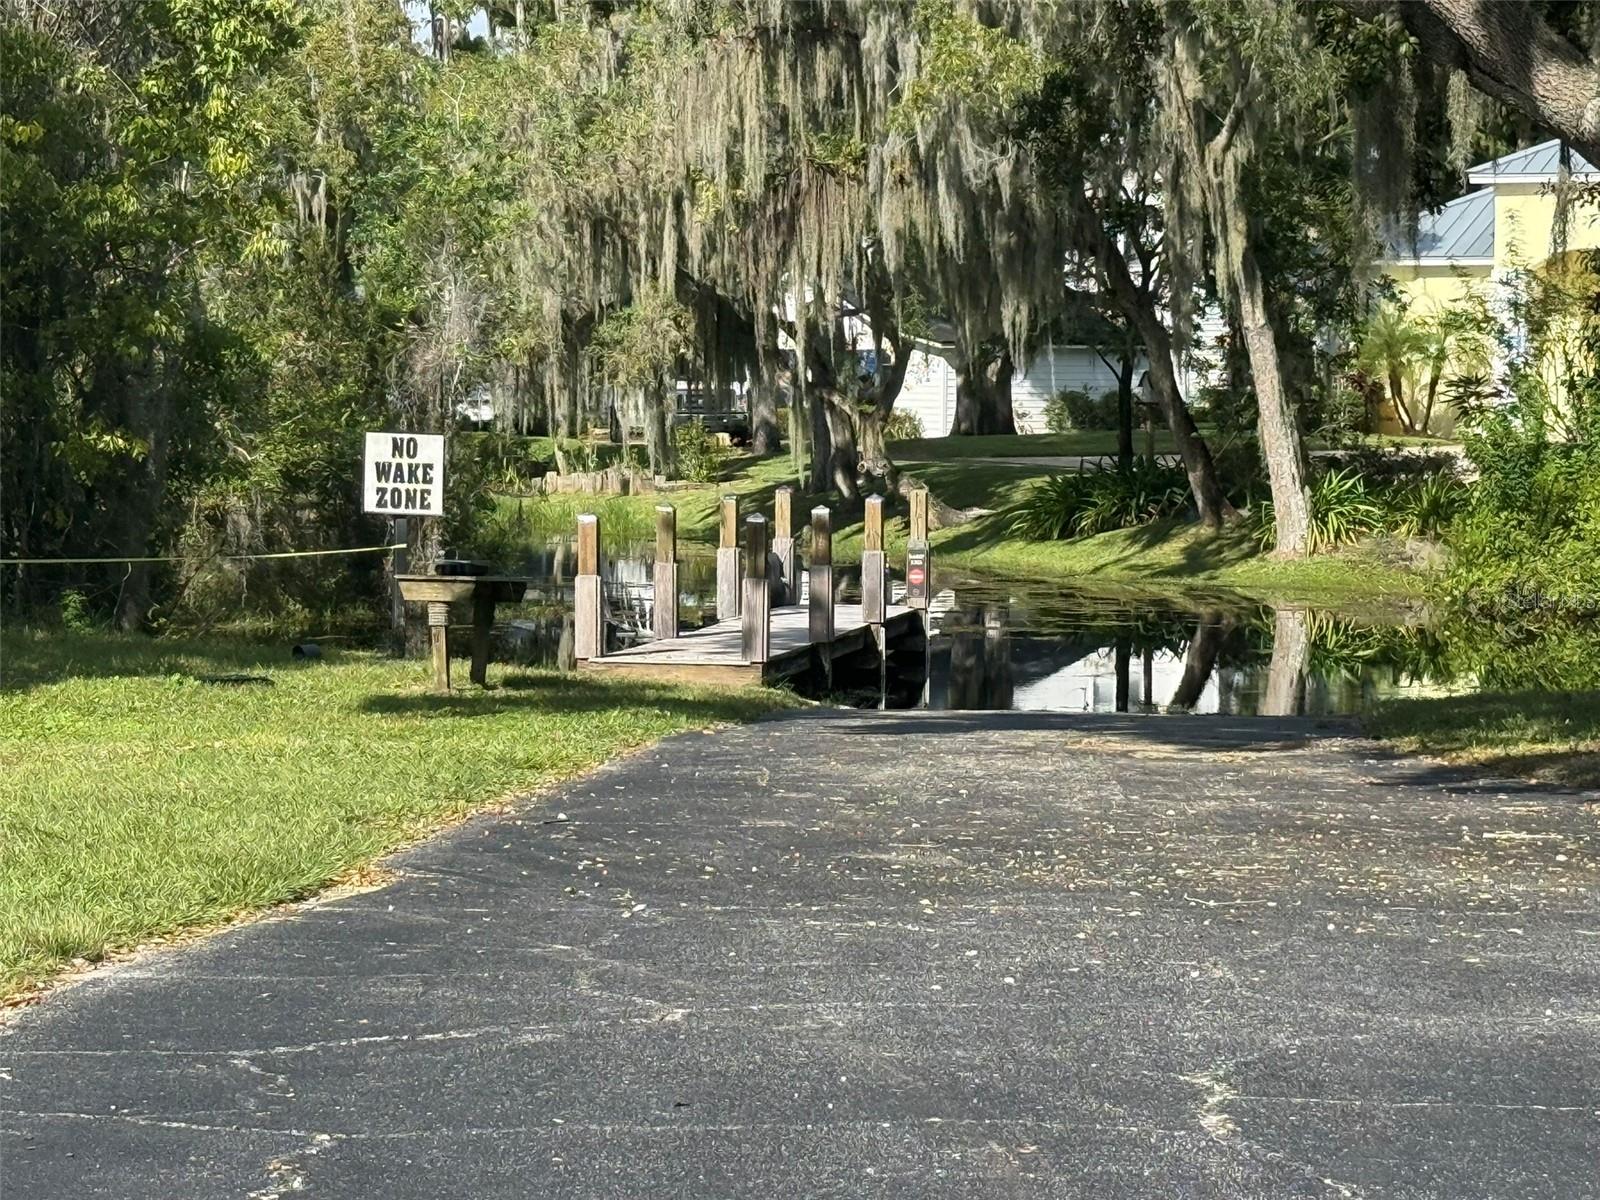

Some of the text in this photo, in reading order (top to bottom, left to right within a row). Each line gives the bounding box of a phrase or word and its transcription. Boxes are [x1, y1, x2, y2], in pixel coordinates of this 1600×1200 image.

[391, 436, 418, 459] NO
[374, 461, 434, 485] WAKE
[375, 486, 432, 510] ZONE
